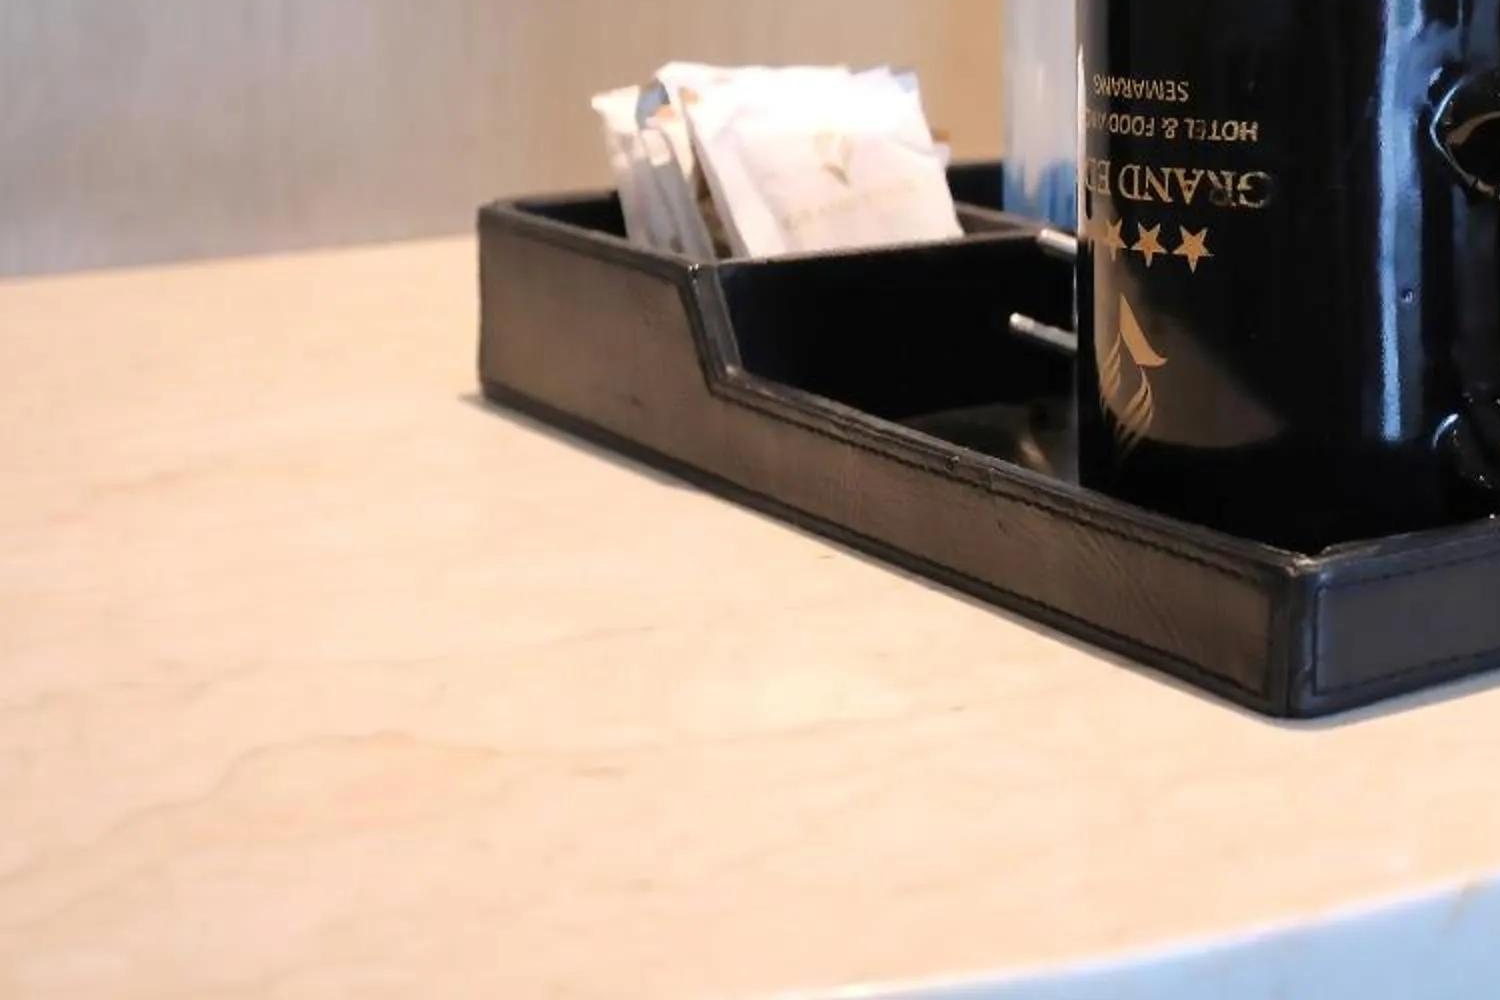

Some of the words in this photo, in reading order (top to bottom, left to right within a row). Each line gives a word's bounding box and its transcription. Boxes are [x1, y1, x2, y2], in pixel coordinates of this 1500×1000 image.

[1093, 73, 1189, 102] SEMARANG
[1109, 112, 1155, 138] FOOD
[1161, 117, 1179, 140] &
[1183, 117, 1259, 142] HOTEL
[1118, 163, 1272, 209] GRAND
